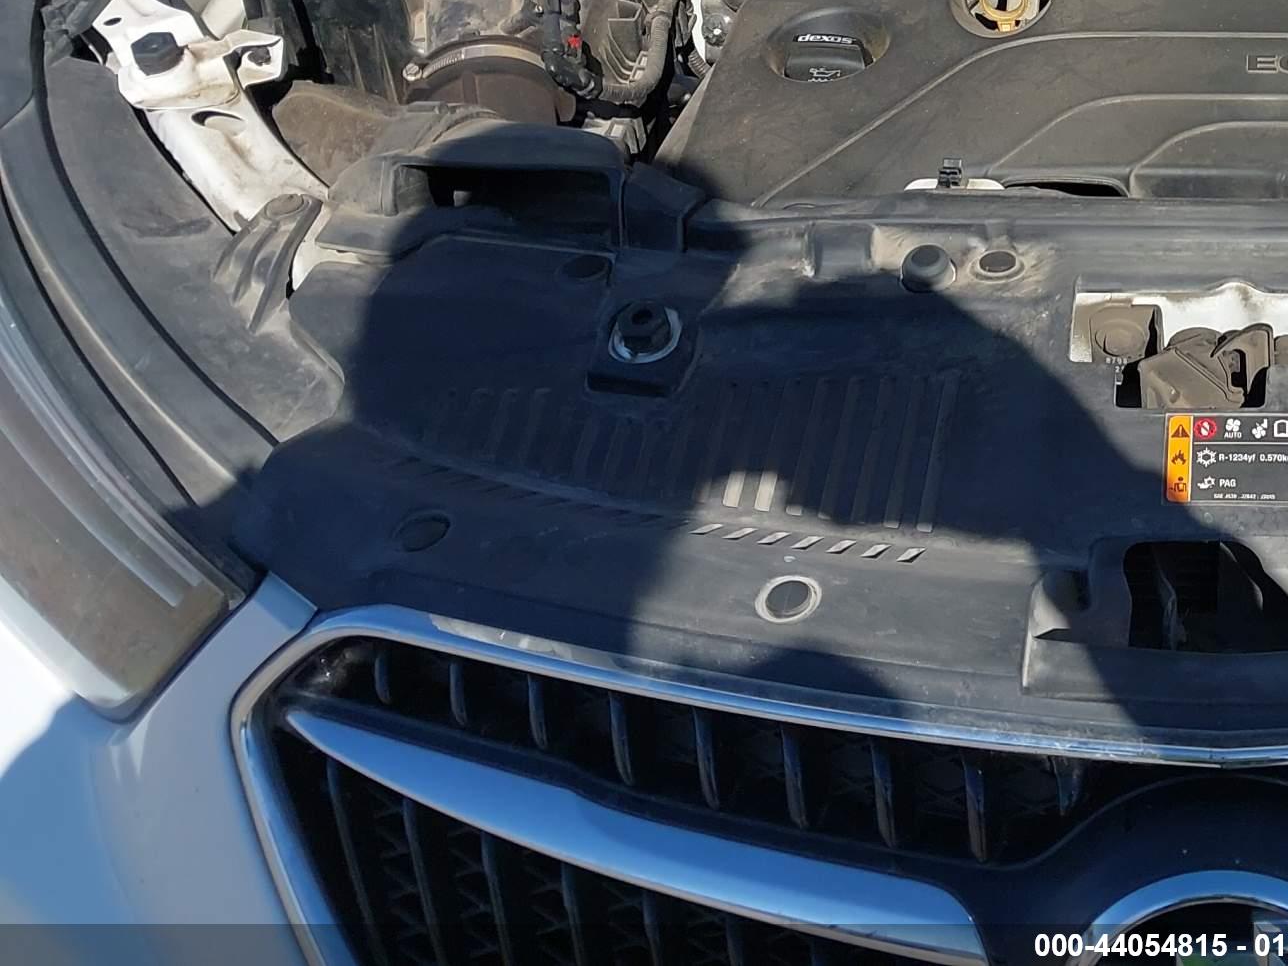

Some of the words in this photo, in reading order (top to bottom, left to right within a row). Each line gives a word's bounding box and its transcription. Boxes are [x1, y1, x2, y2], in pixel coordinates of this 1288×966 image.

[798, 34, 853, 44] dexos
[1218, 453, 1256, 463] R-1234yf
[1219, 479, 1236, 487] PAG
